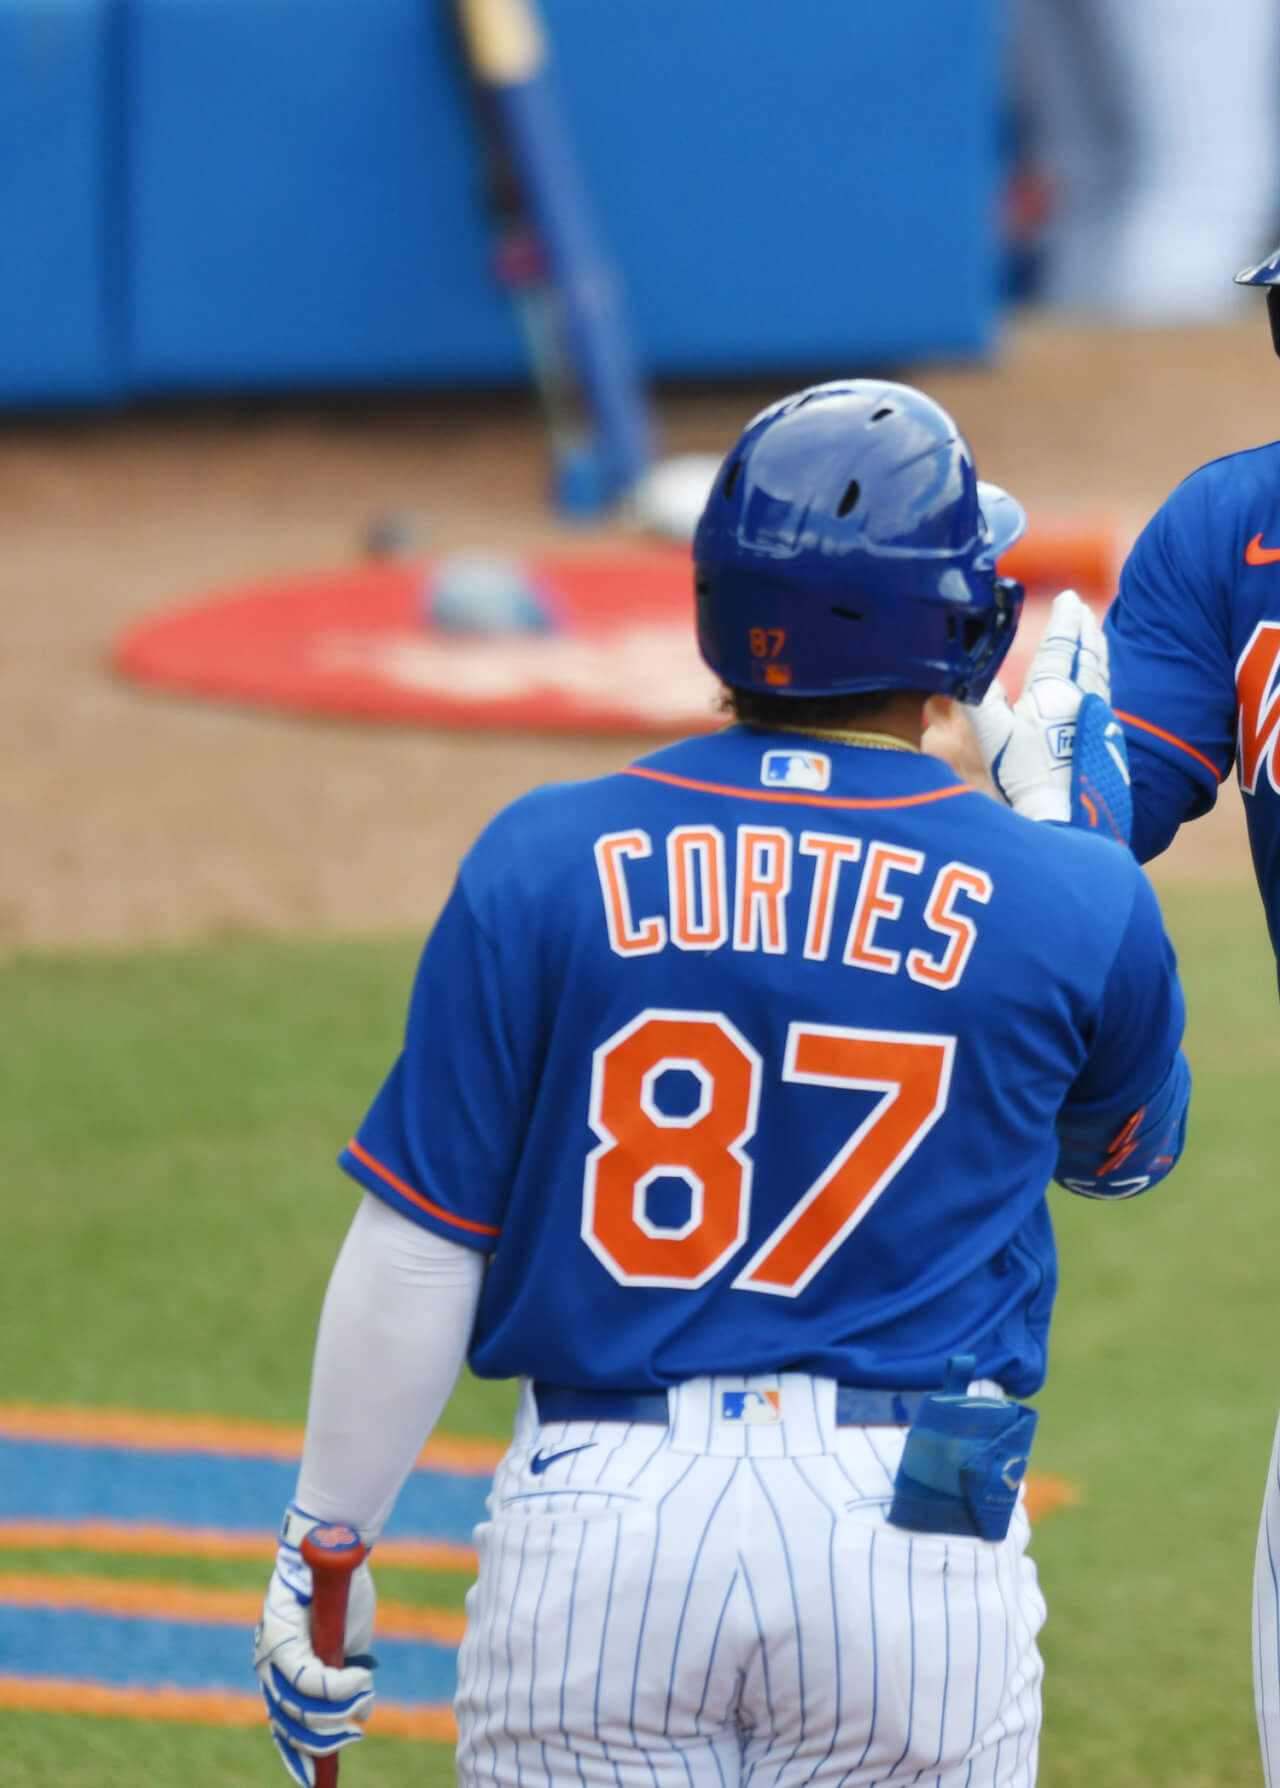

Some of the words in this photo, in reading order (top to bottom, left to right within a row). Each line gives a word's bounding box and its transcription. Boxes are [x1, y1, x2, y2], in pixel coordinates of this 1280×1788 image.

[749, 626, 787, 660] 87
[594, 824, 993, 991] CORTES
[581, 1008, 957, 1298] 87
